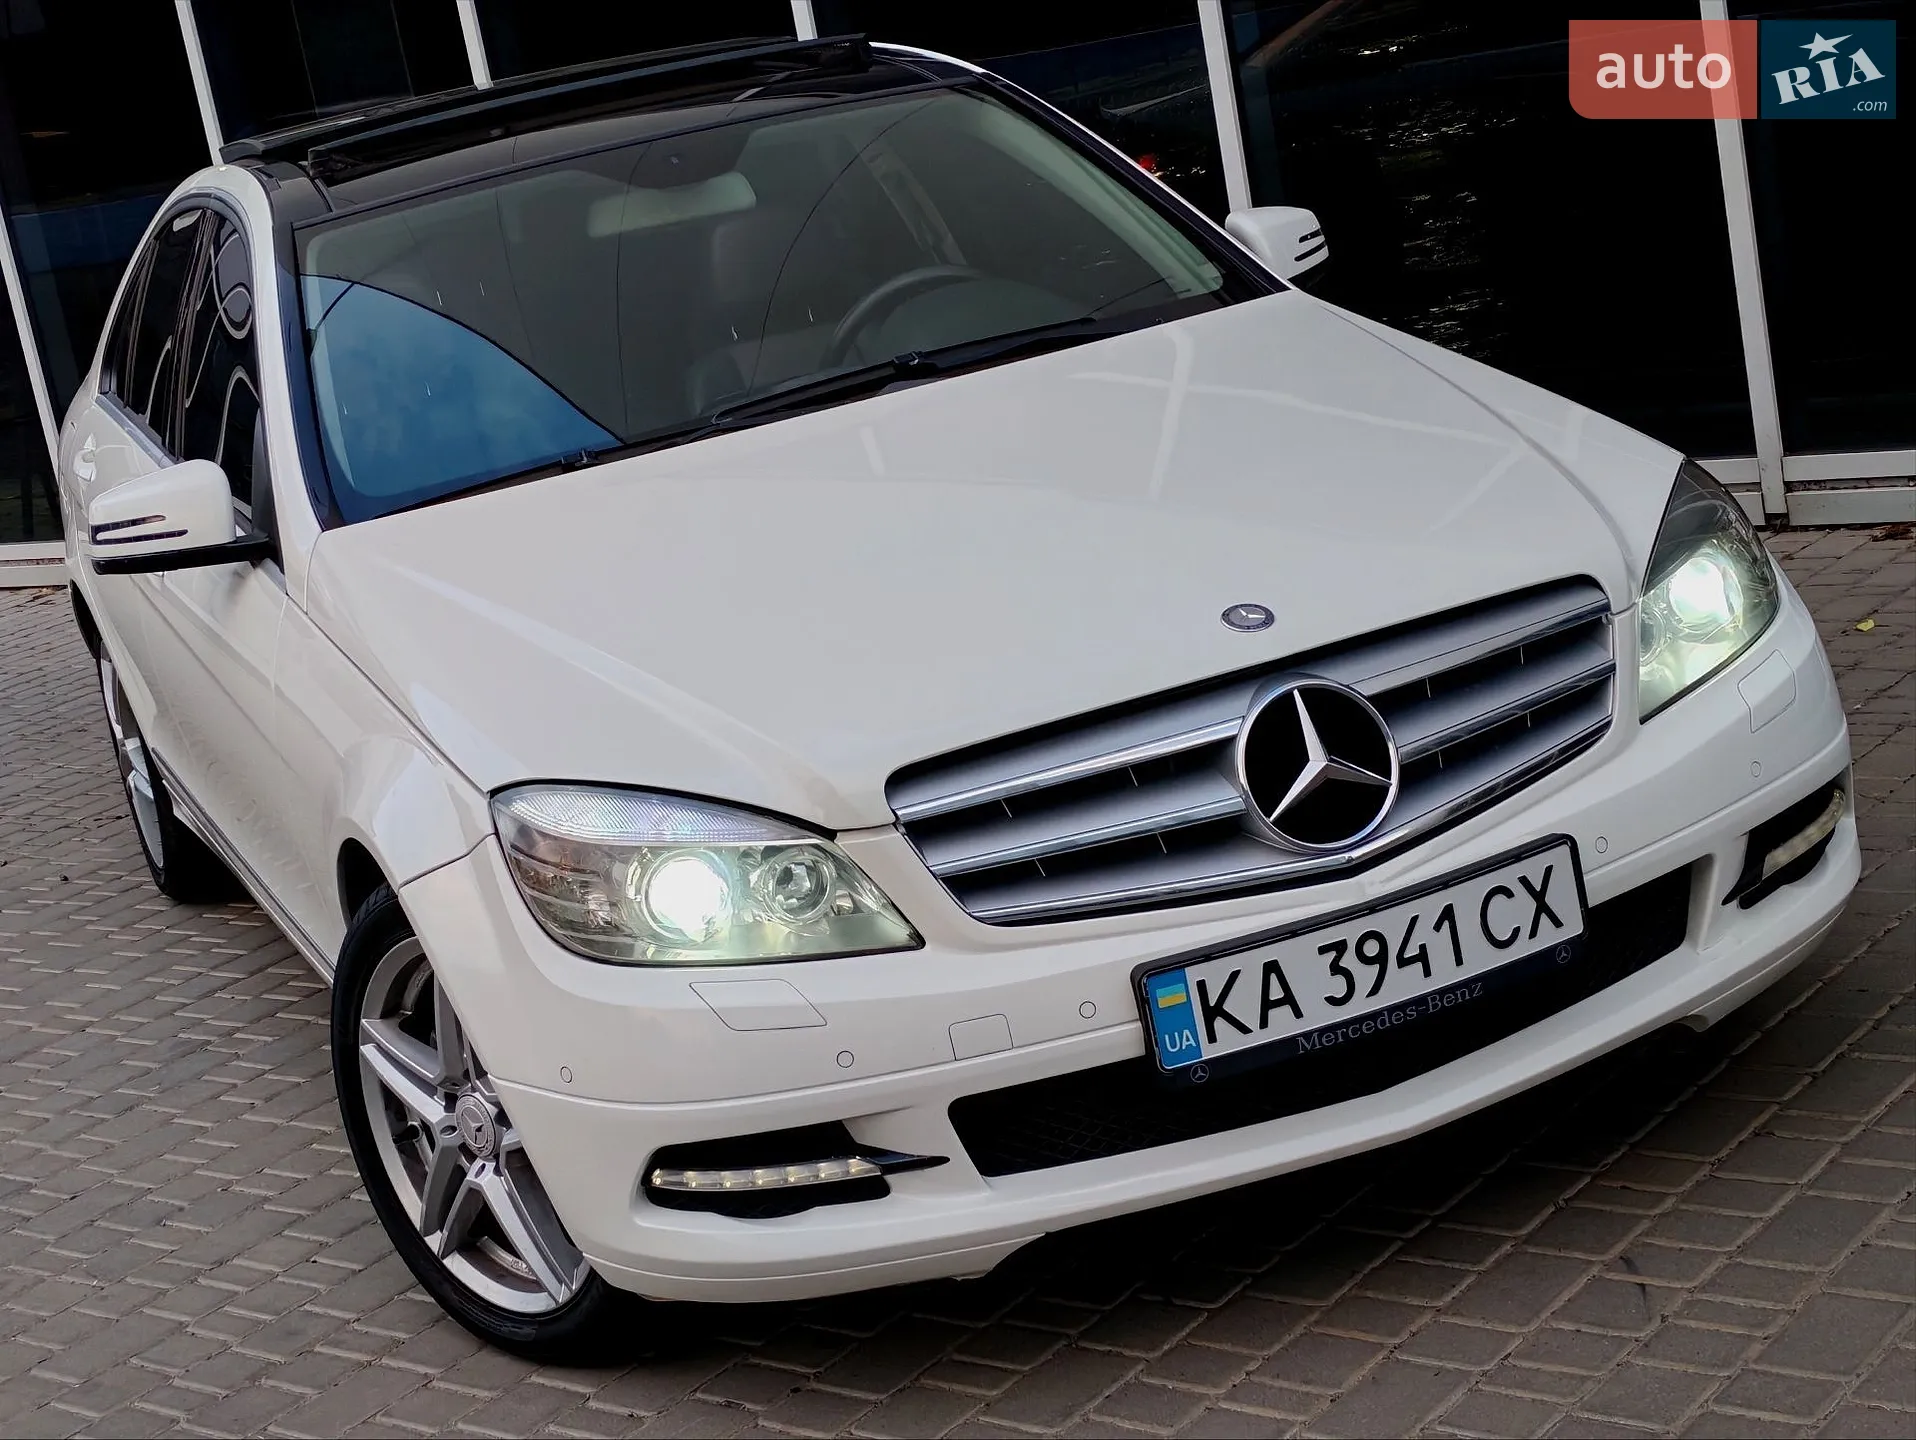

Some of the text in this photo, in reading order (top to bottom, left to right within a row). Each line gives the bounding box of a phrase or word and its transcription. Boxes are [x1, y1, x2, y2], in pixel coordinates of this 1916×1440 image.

[1195, 864, 1564, 1044] KA 3941 CX
[1165, 1029, 1196, 1052] UA
[1296, 982, 1484, 1054] Mercedes-Benz
